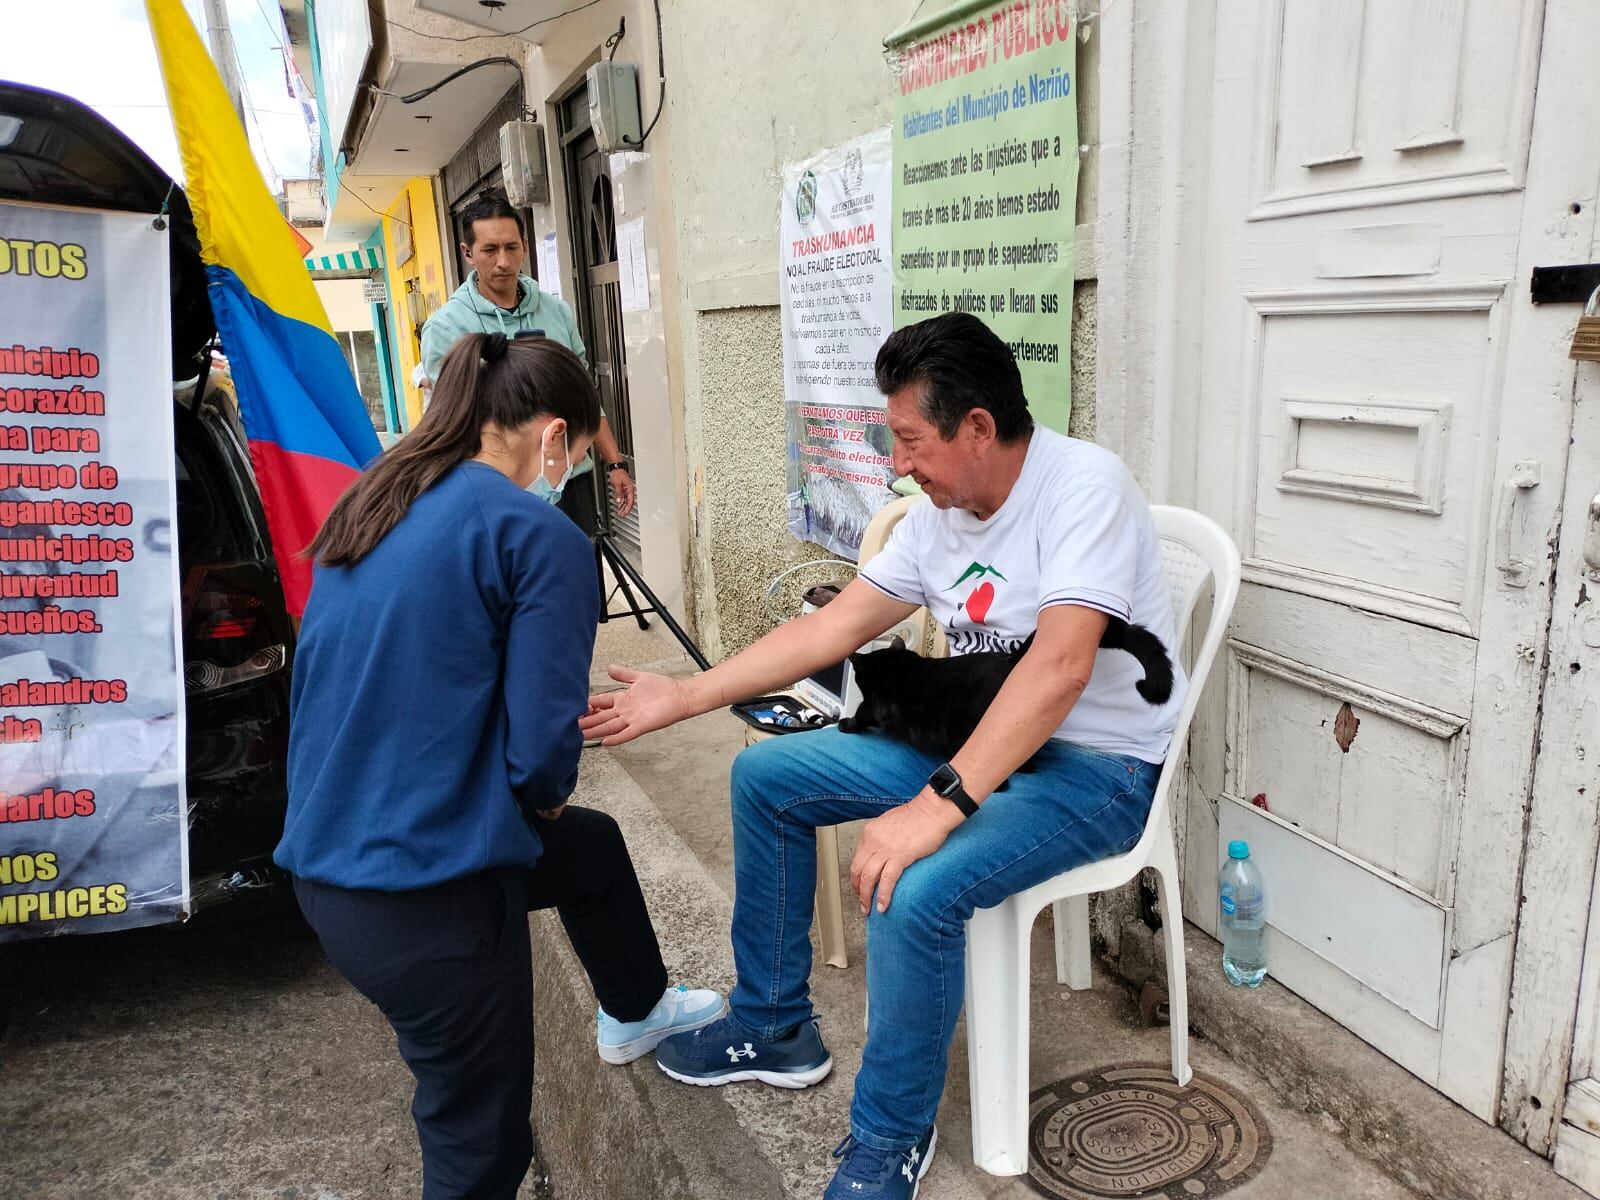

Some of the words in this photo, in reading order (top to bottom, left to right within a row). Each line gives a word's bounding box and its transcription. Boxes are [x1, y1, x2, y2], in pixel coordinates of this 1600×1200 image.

[903, 108, 943, 139] Habitantes
[946, 97, 959, 127] del
[963, 85, 1008, 121] Municipio
[1013, 79, 1026, 109] de
[1029, 67, 1071, 104] Nariño
[903, 159, 948, 186] Reaccionemos
[950, 152, 967, 177] ante
[971, 147, 983, 173] las
[986, 138, 1027, 176] injusticias
[1031, 137, 1049, 168] que
[1054, 135, 1061, 157] a
[902, 204, 922, 228] través
[925, 202, 933, 226] de
[935, 200, 949, 225] más
[951, 199, 960, 223] de
[962, 195, 971, 222] 20
[974, 195, 993, 220] años
[997, 192, 1023, 217] hemos
[1027, 183, 1060, 213] estado
[792, 223, 875, 258] TRASHUMANCIA
[901, 246, 934, 270] sometidos
[937, 250, 948, 274] por
[951, 249, 960, 267] un
[963, 247, 985, 273] grupo
[988, 241, 998, 266] de
[1002, 236, 1058, 271] saqueadores
[786, 264, 796, 278] NO
[798, 262, 806, 276] AL
[807, 257, 835, 275] FRAUDE
[836, 248, 882, 270] ELECTORAL
[901, 289, 937, 311] disfrazados
[941, 289, 950, 312] de
[990, 293, 1005, 318] que
[1009, 288, 1035, 313] llenan
[1040, 293, 1058, 314] sus
[845, 409, 865, 422] QUE
[866, 411, 886, 424] ESTO
[31, 426, 100, 454] para
[842, 429, 864, 442] VEZ
[80, 461, 118, 490] de
[1048, 1090, 1156, 1134] ACUEDUCTO
